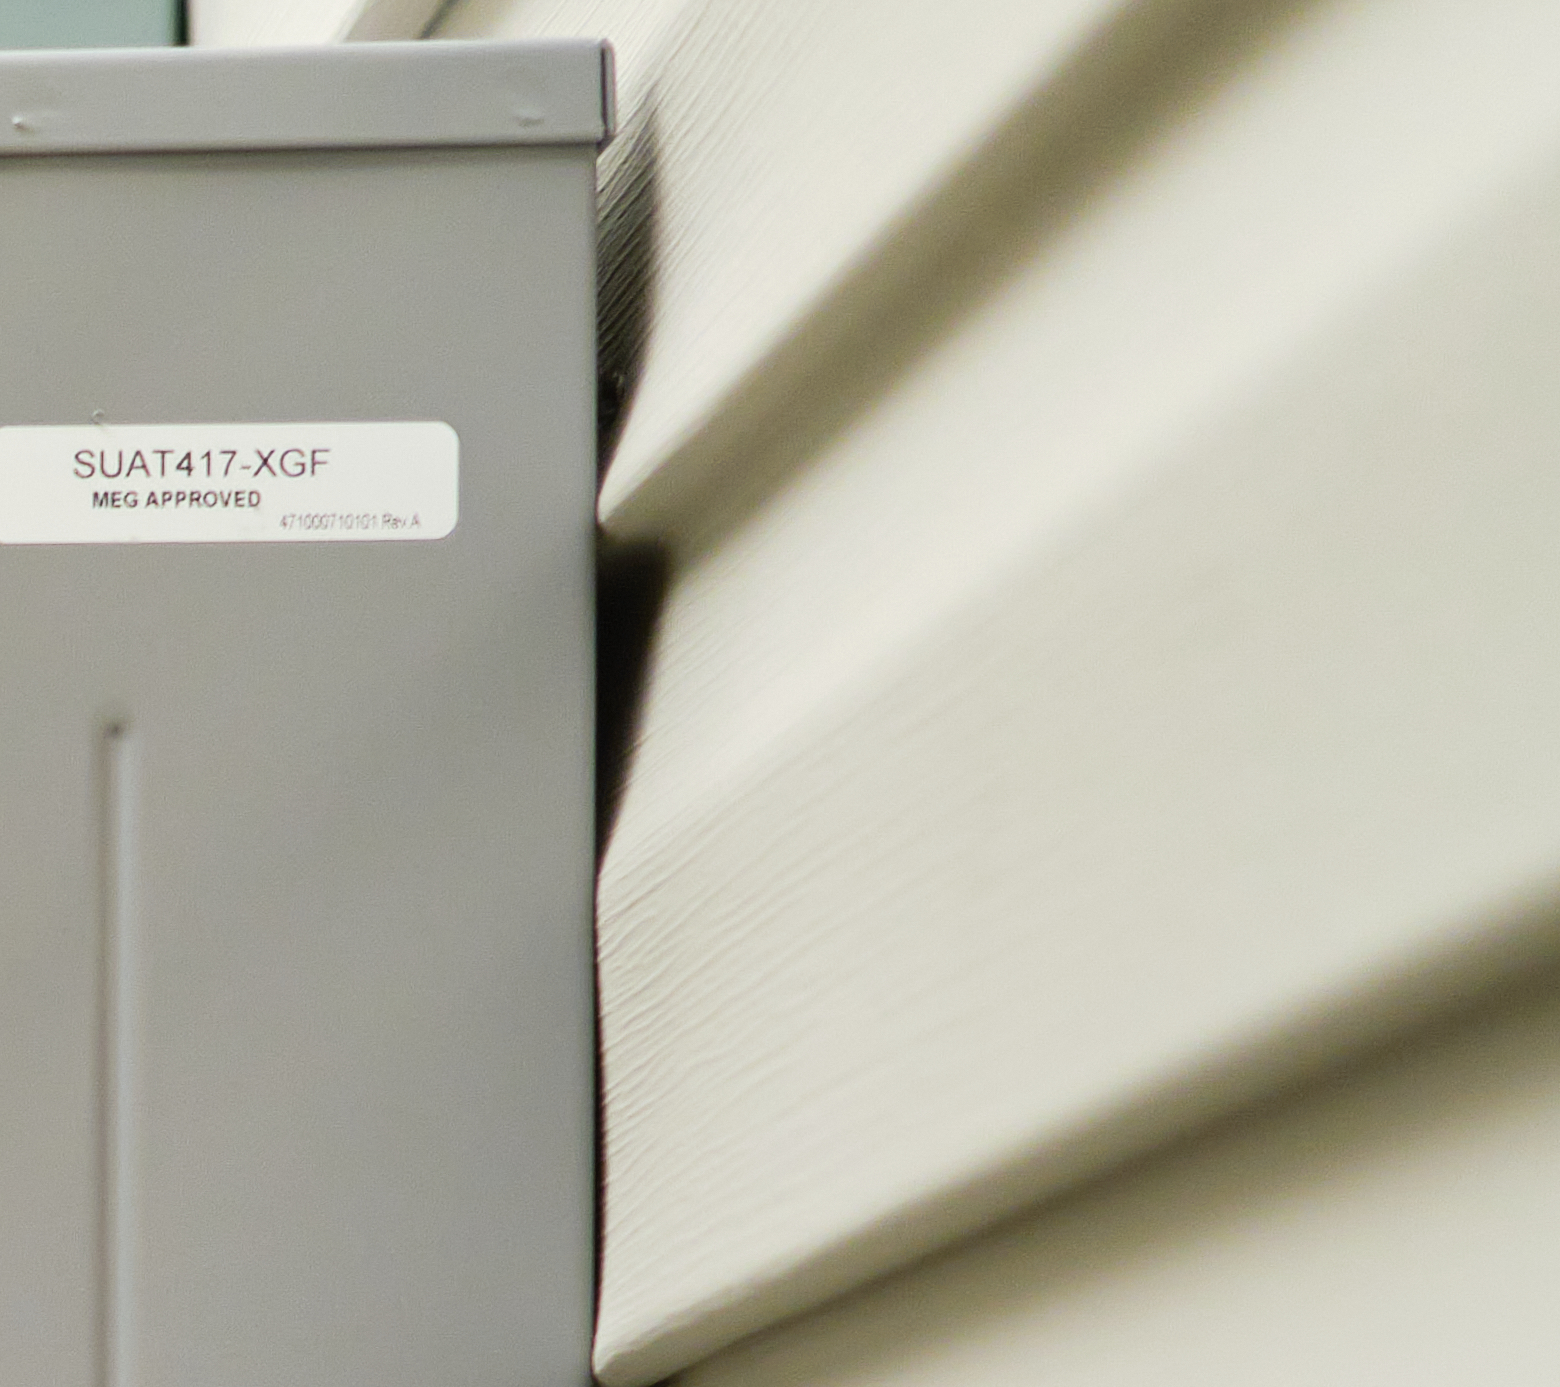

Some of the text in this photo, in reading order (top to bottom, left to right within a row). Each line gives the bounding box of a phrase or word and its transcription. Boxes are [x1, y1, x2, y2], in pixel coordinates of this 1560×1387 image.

[73, 448, 331, 479] SUAT417-XGF
[92, 489, 261, 509] MEG APPROVED
